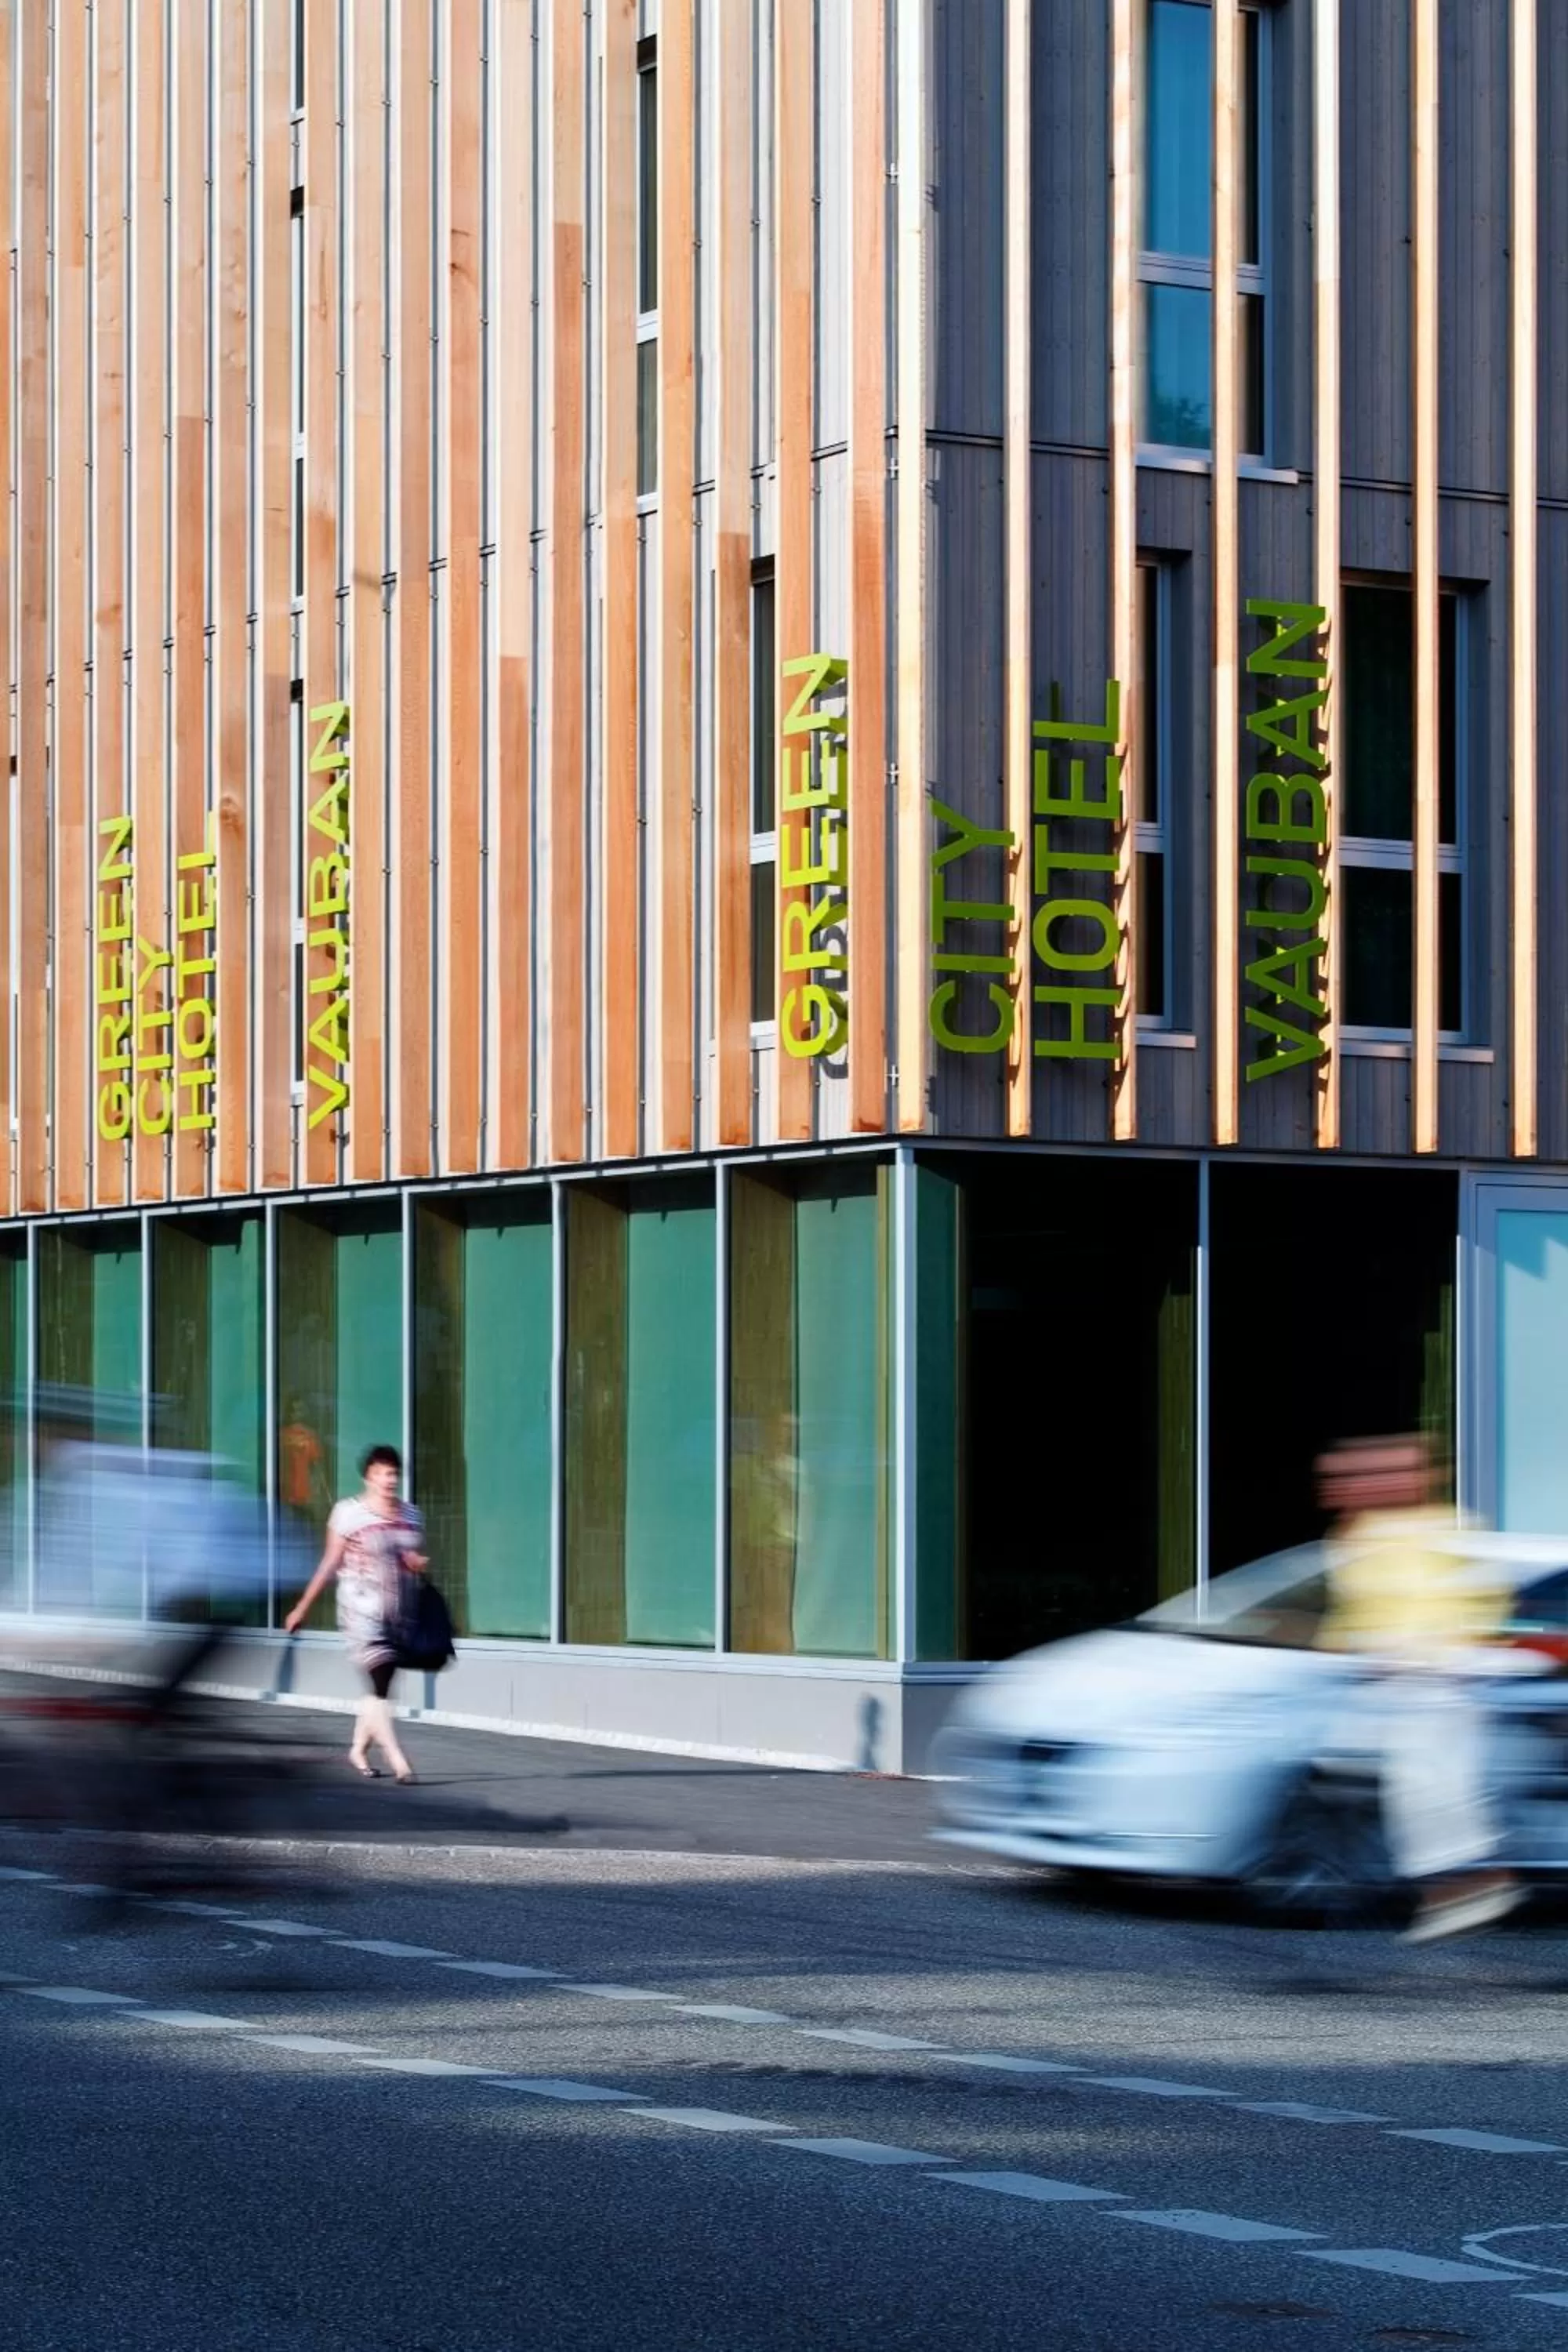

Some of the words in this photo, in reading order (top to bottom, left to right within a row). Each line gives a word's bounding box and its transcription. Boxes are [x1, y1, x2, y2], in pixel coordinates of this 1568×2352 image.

[98, 815, 132, 1141] GREEN
[178, 810, 216, 1131] HOTEL
[308, 700, 350, 1130] VAUBAN
[782, 652, 833, 1059] GREEN
[929, 796, 1015, 1054] CITY
[1033, 678, 1122, 1059] HOTEL
[1245, 598, 1329, 1082] VAUBAN
[137, 935, 171, 1136] CITY
